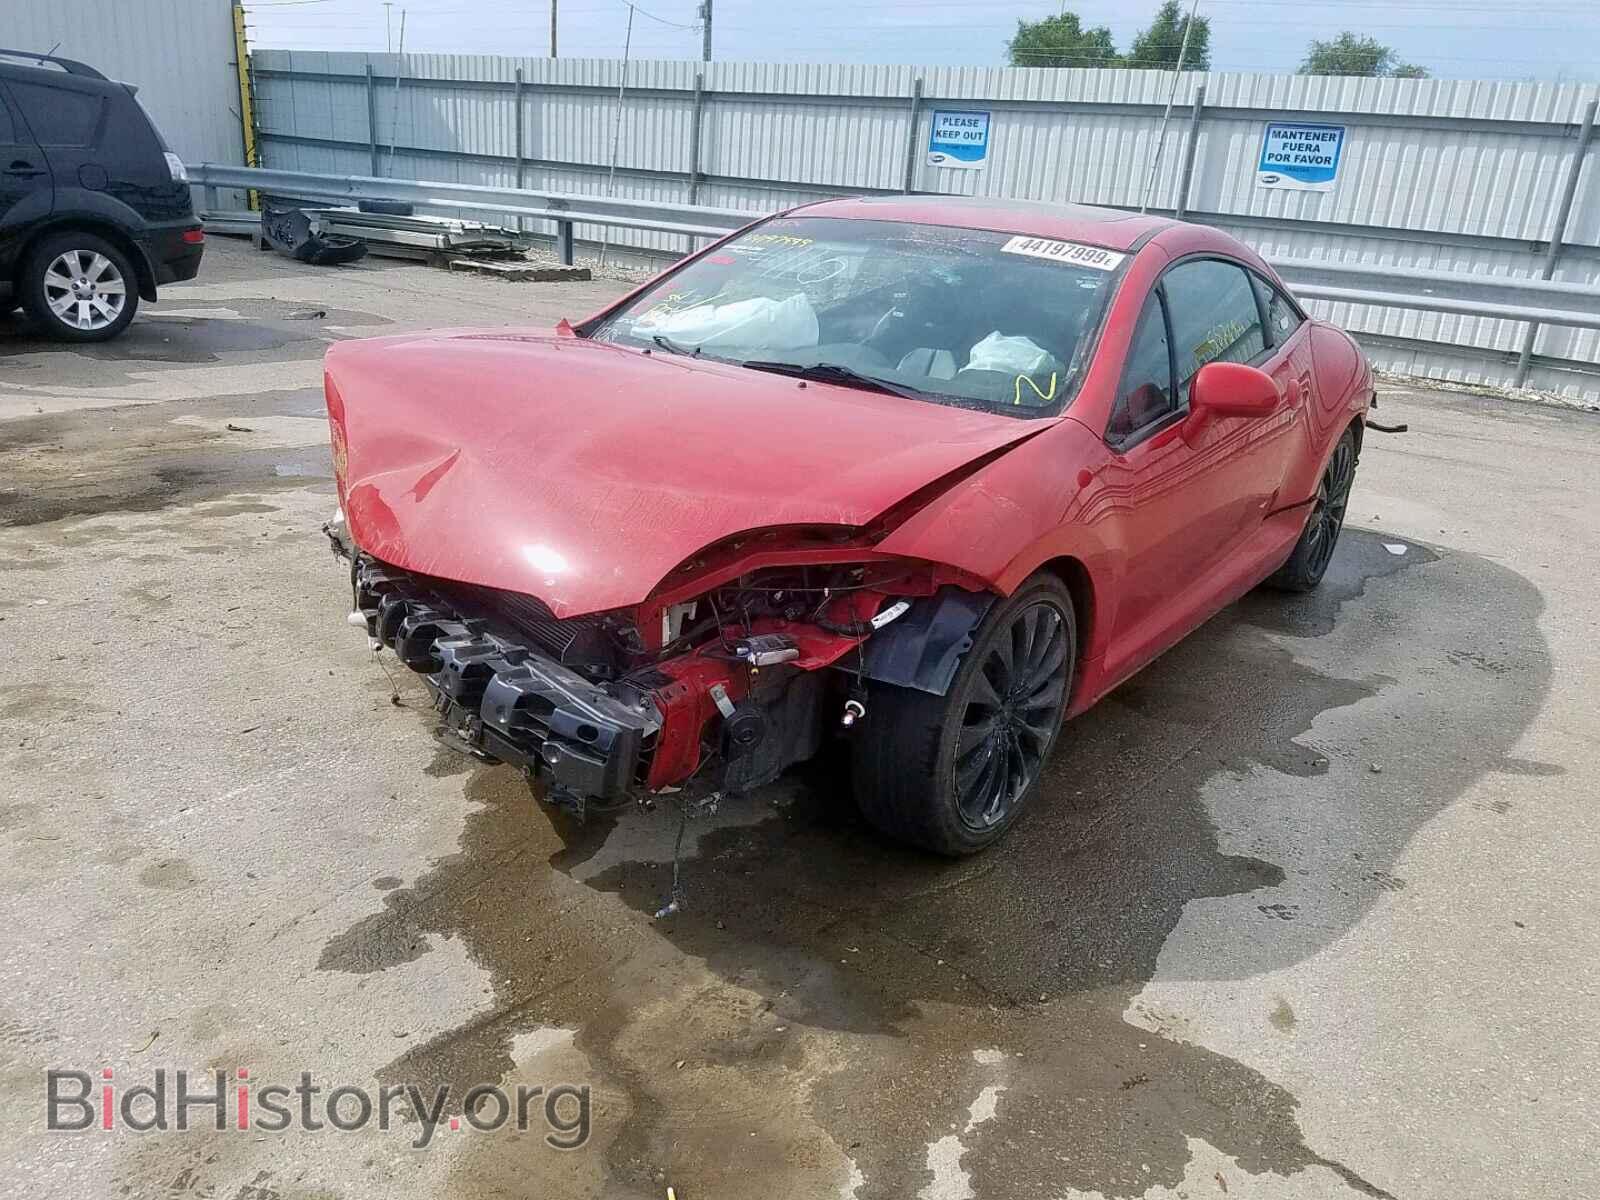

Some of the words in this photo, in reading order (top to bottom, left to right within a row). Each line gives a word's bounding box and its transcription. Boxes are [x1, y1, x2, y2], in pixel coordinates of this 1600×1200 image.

[942, 117, 979, 128] PLEASE
[936, 129, 960, 139] KEEP
[963, 132, 984, 141] OUT
[1271, 130, 1337, 142] MANTENER
[1282, 142, 1320, 153] FUERA
[1267, 152, 1291, 162] POR
[1294, 154, 1332, 165] FAVOR
